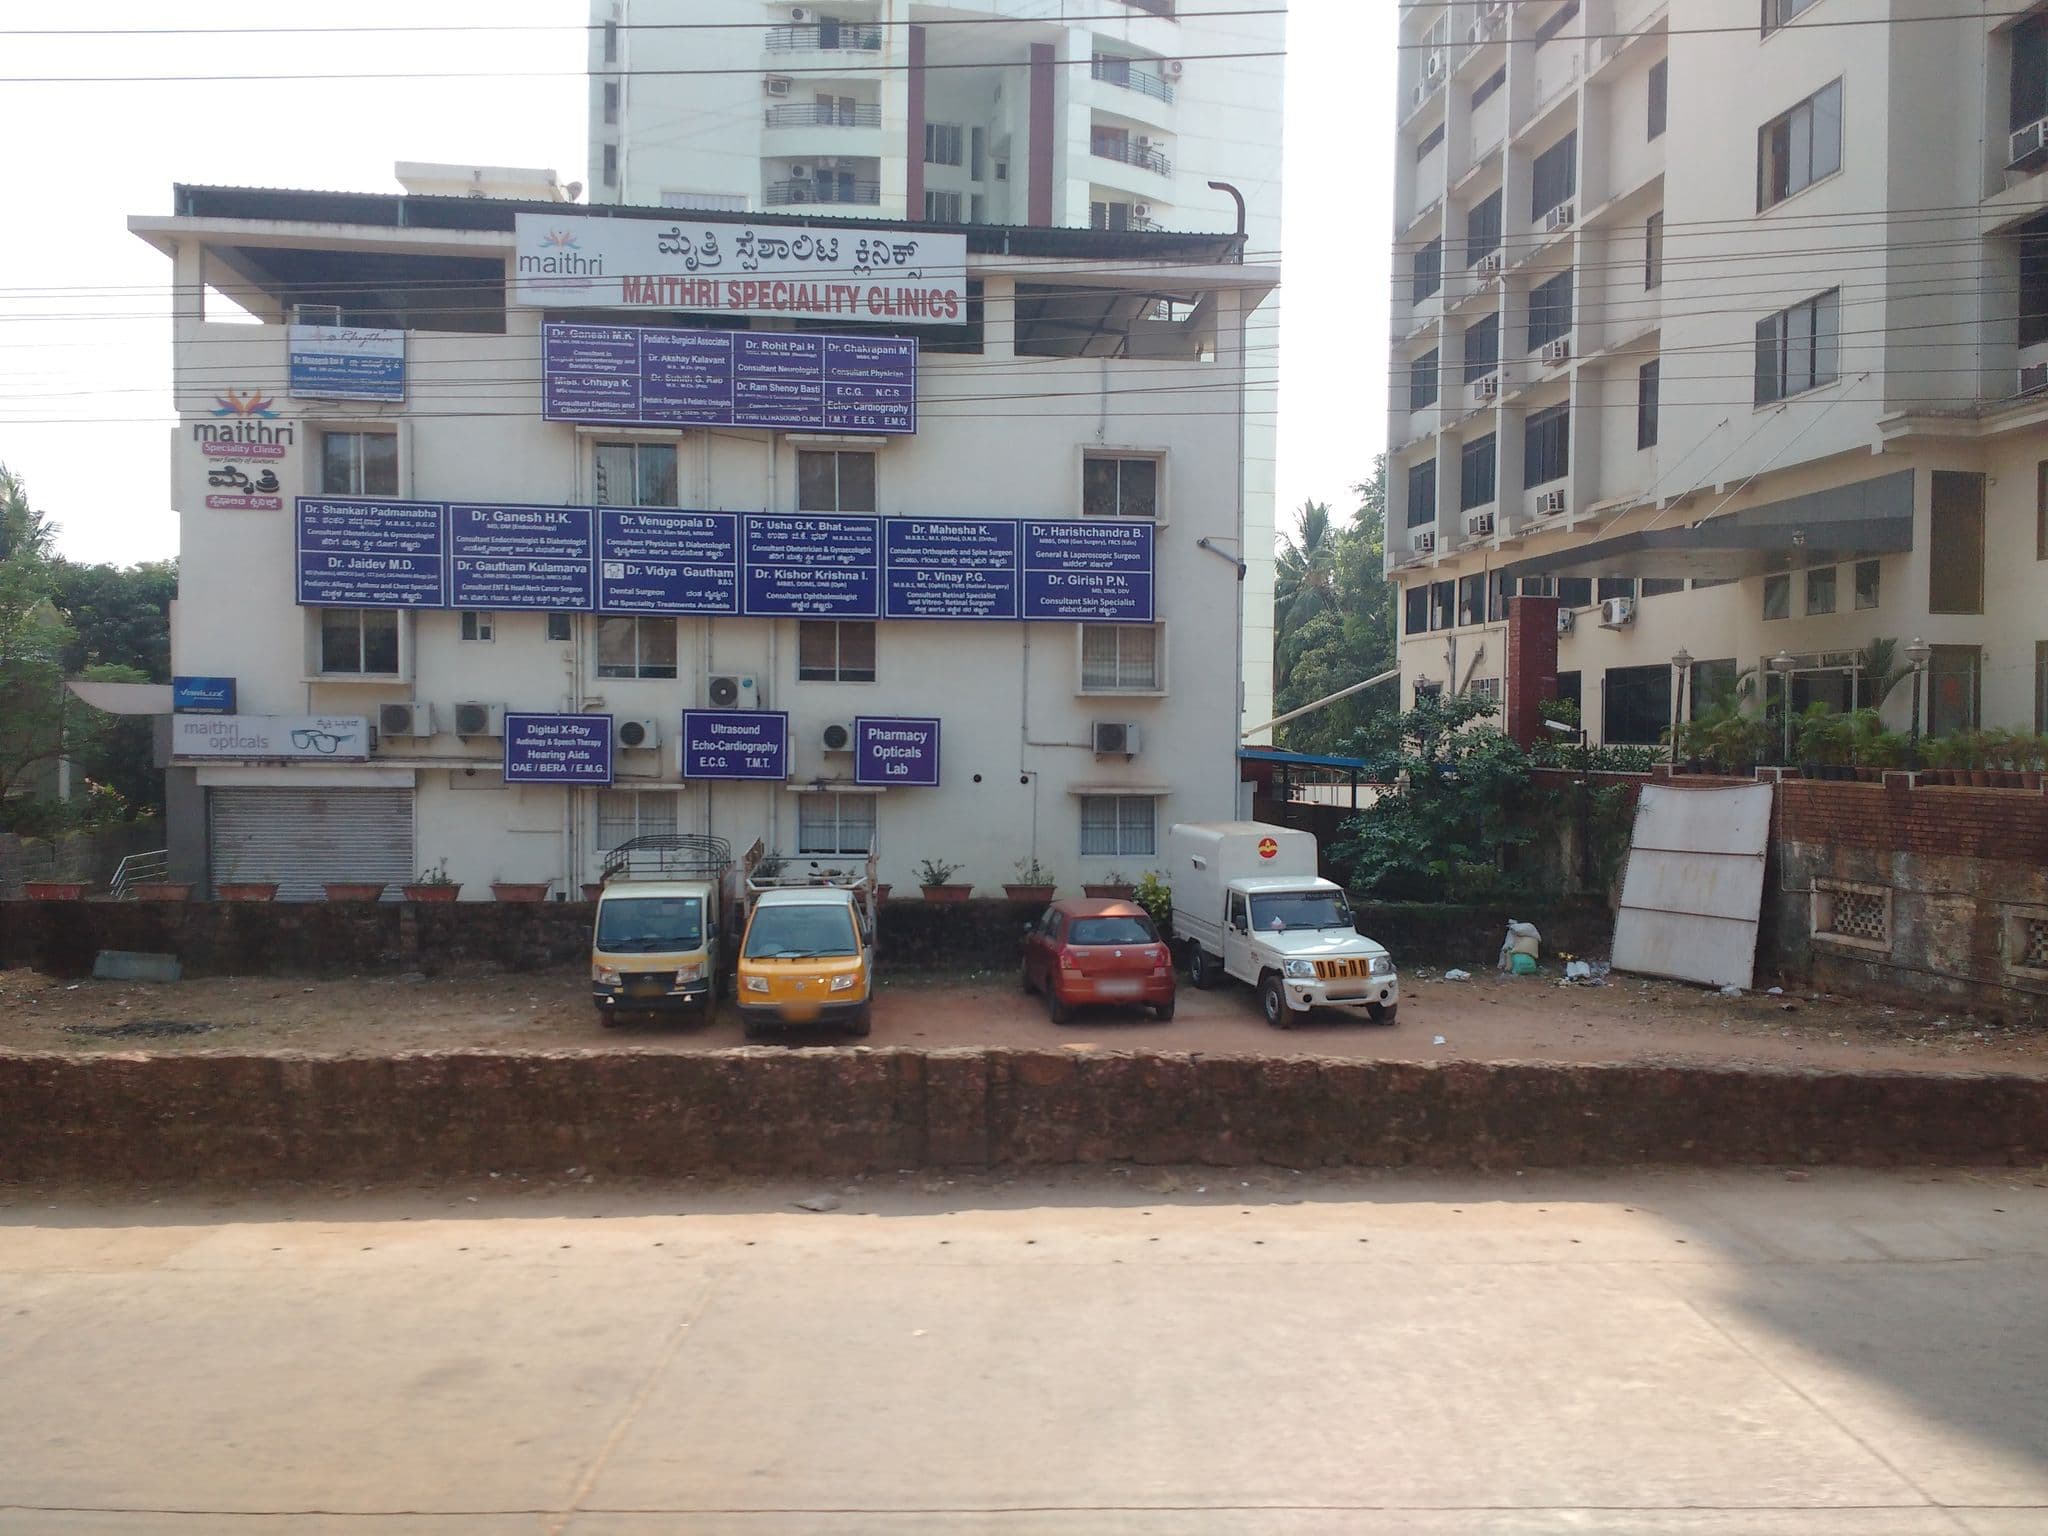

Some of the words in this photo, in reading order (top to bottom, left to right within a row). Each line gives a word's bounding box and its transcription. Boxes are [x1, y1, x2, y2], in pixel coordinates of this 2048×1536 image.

[658, 227, 722, 272] ಮೈತ್ರಿ
[520, 252, 603, 275] maithri
[623, 275, 720, 307] MAITHRI
[728, 280, 862, 315] SPECIALITY
[868, 286, 959, 318] CLINICS
[552, 328, 567, 338] Dr.
[746, 340, 759, 349] Dr.
[762, 342, 787, 350] Rohit
[807, 343, 815, 351] H
[828, 344, 842, 352] Dr.
[738, 364, 777, 373] Consultant
[778, 365, 819, 376] Neurologist
[737, 382, 749, 391] Dr.
[750, 383, 768, 391] Ram
[770, 384, 799, 394] Shenoy
[801, 385, 820, 394] Basti
[194, 421, 293, 445] maithri
[204, 444, 250, 454] Speciality
[252, 445, 282, 454] Clinics
[305, 505, 320, 514] Dr.
[323, 506, 368, 516] Shankari
[371, 507, 437, 518] Padmanabha
[472, 511, 490, 521] Dr.
[493, 511, 542, 522] Ganesh
[545, 513, 572, 524] H.K.
[620, 515, 636, 525] Dr.
[638, 516, 703, 528] Venugopala
[706, 518, 718, 528] D.
[751, 520, 765, 529] Dr.
[767, 521, 793, 530] Usha
[795, 522, 816, 531] G.K.
[819, 522, 842, 531] Bhat
[912, 524, 927, 534] Dr.
[930, 525, 977, 535] Mahesha
[979, 526, 990, 535] K.
[1032, 526, 1048, 536] Dr.
[1051, 526, 1130, 538] Harishchandra
[1133, 528, 1144, 538] B.
[645, 540, 679, 548] Physician
[686, 541, 731, 550] Diabetologist
[1036, 550, 1062, 558] General
[1070, 552, 1112, 560] Laparoscopic
[1114, 552, 1141, 561] Surgeon
[328, 558, 345, 568] Dr.
[348, 558, 387, 570] Jaidev
[389, 560, 415, 570] M.D.
[458, 561, 473, 571] Dr.
[476, 561, 526, 572] Gautham
[528, 562, 587, 573] Kulamarva
[627, 566, 642, 575] Dr.
[645, 566, 677, 578] Vidya
[683, 567, 734, 578] Gautham
[755, 569, 772, 579] Dr.
[774, 570, 813, 580] Kishor
[815, 571, 859, 580] Krishna
[917, 572, 932, 581] Dr.
[934, 572, 963, 584] Vinay
[966, 572, 986, 582] P.G.
[1048, 575, 1065, 585] Dr.
[1068, 575, 1103, 586] Girish
[1106, 576, 1128, 587] P.N.
[636, 588, 665, 597] Surgeon
[766, 592, 803, 600] Consultant
[620, 600, 656, 608] Speciality
[1040, 597, 1081, 606] Consultant
[1083, 598, 1099, 606] Skin
[1100, 599, 1136, 607] Specialist
[184, 720, 239, 736] maithri
[528, 725, 559, 736] Digital
[562, 726, 591, 737] X-Ray
[711, 724, 760, 735] Ultrasound
[210, 734, 269, 751] opticals
[868, 728, 928, 745] Pharmacy
[692, 740, 779, 754] Echo-Cardiography
[873, 746, 922, 759] Opticals
[528, 750, 566, 761] Hearing
[568, 751, 590, 760] Aids
[512, 764, 532, 773] OAE
[540, 764, 567, 773] BERA
[576, 764, 606, 774] E.M.G.
[700, 757, 728, 768] E.C.G.
[745, 758, 770, 769] T.M.T.
[886, 763, 909, 775] Lab
